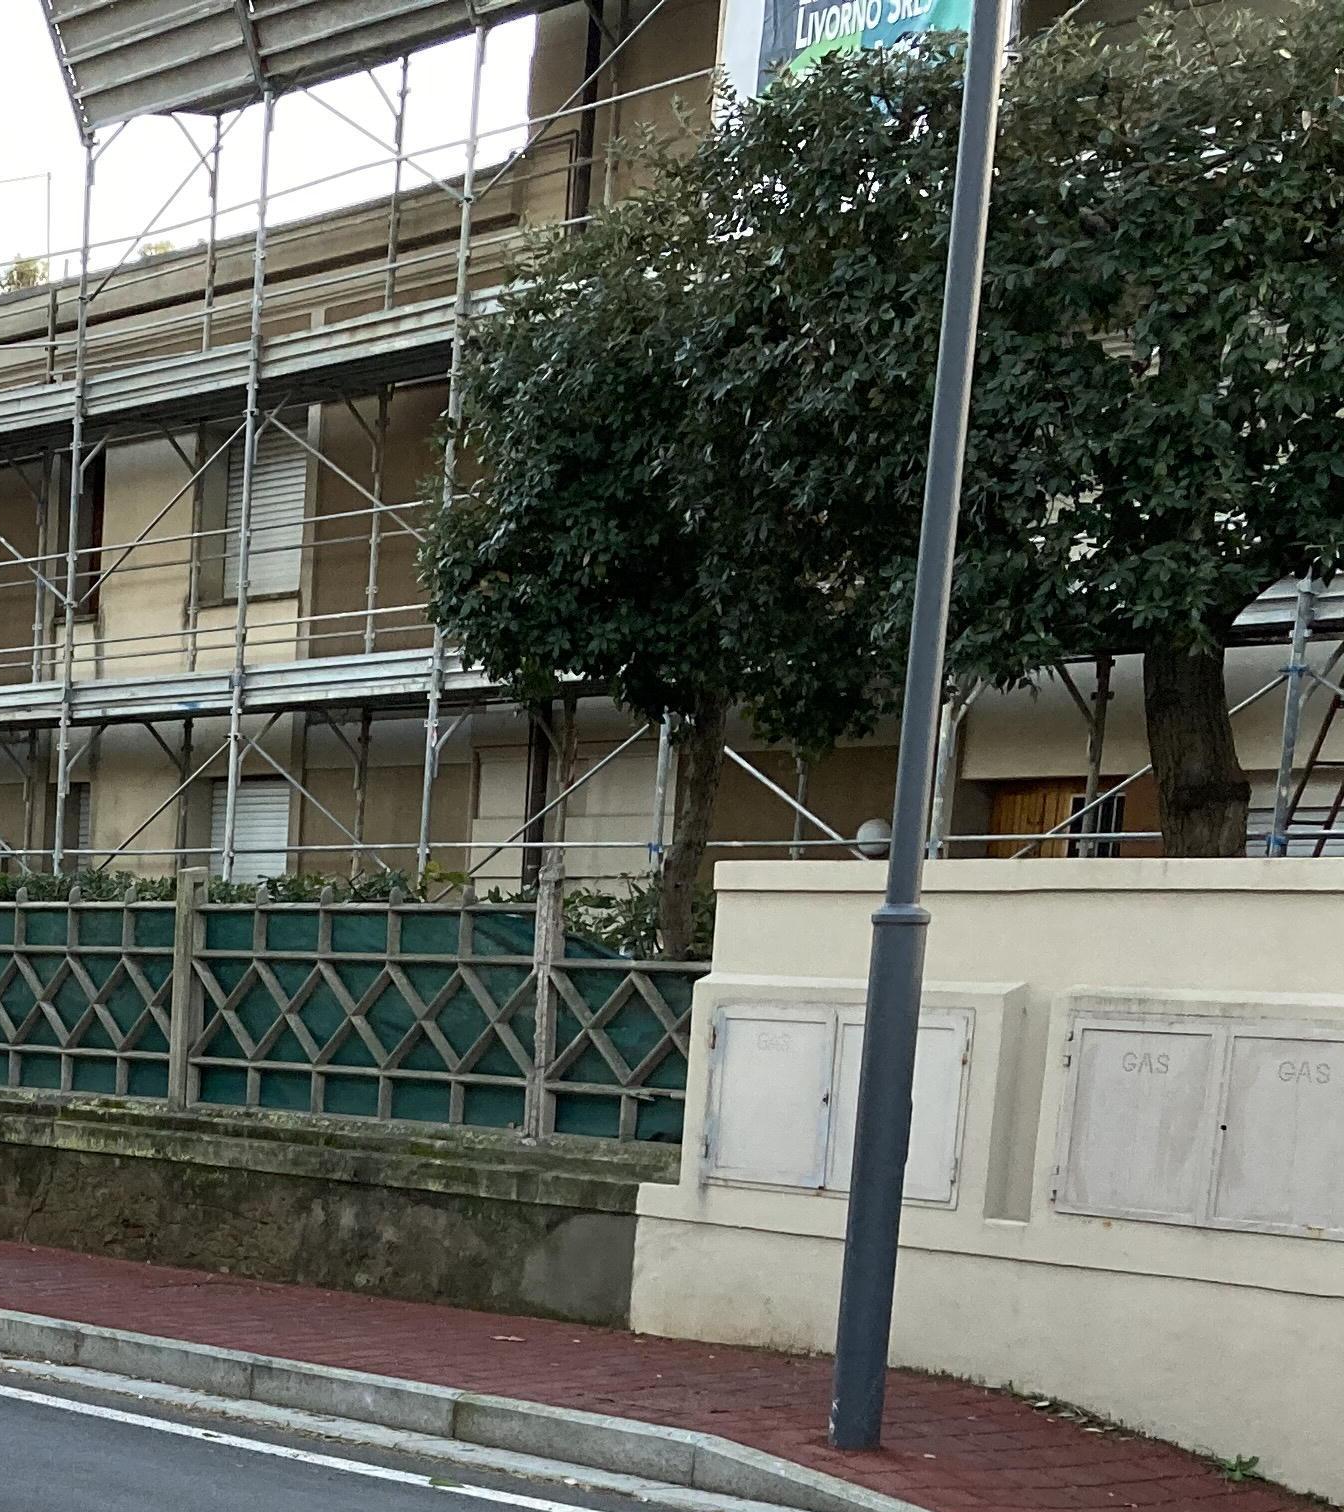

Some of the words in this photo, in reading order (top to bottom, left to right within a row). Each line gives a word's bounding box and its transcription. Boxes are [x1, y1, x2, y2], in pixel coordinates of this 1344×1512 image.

[795, 0, 882, 49] LIVORNO
[1121, 1051, 1170, 1074] GAS
[1277, 1060, 1331, 1084] GAS
